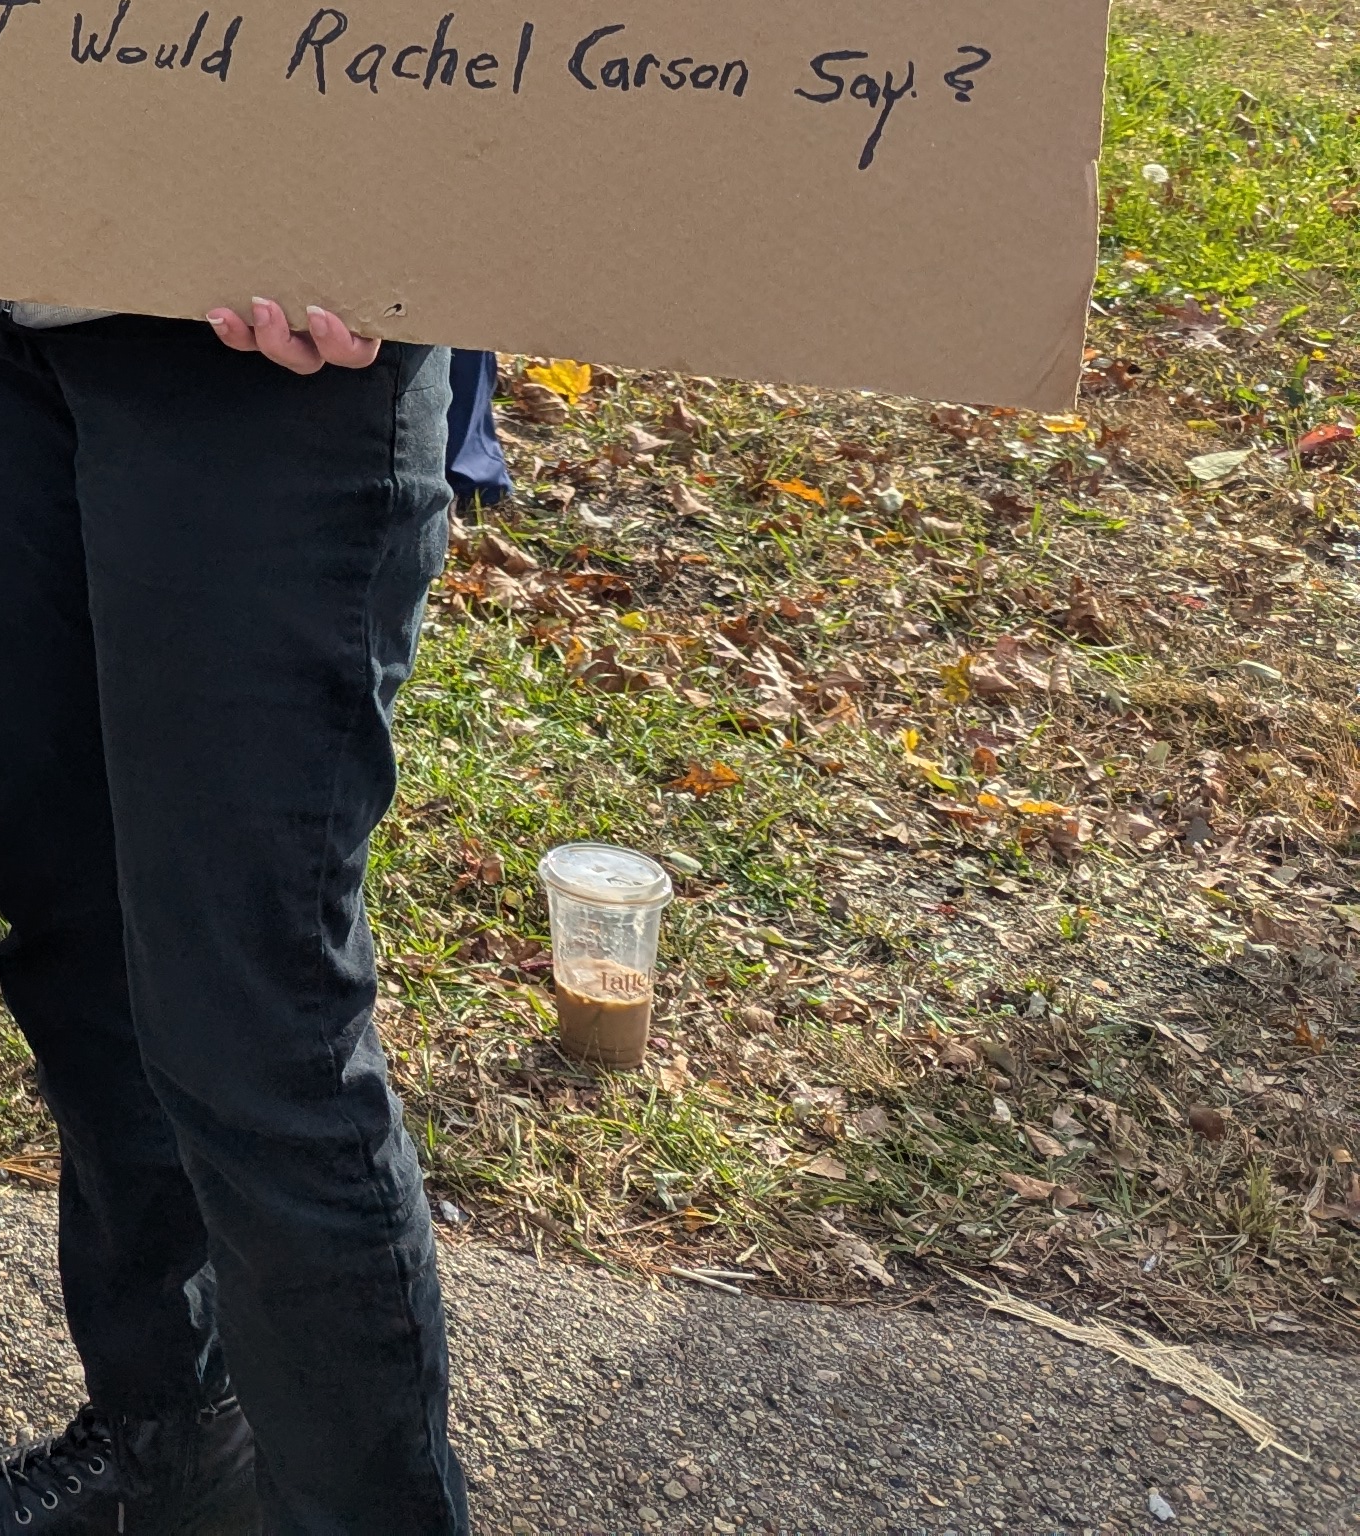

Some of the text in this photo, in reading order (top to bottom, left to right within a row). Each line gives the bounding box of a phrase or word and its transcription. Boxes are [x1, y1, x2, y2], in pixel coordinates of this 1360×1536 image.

[71, 0, 242, 82] Would
[286, 9, 534, 96] Rachel
[567, 23, 750, 98] Carson
